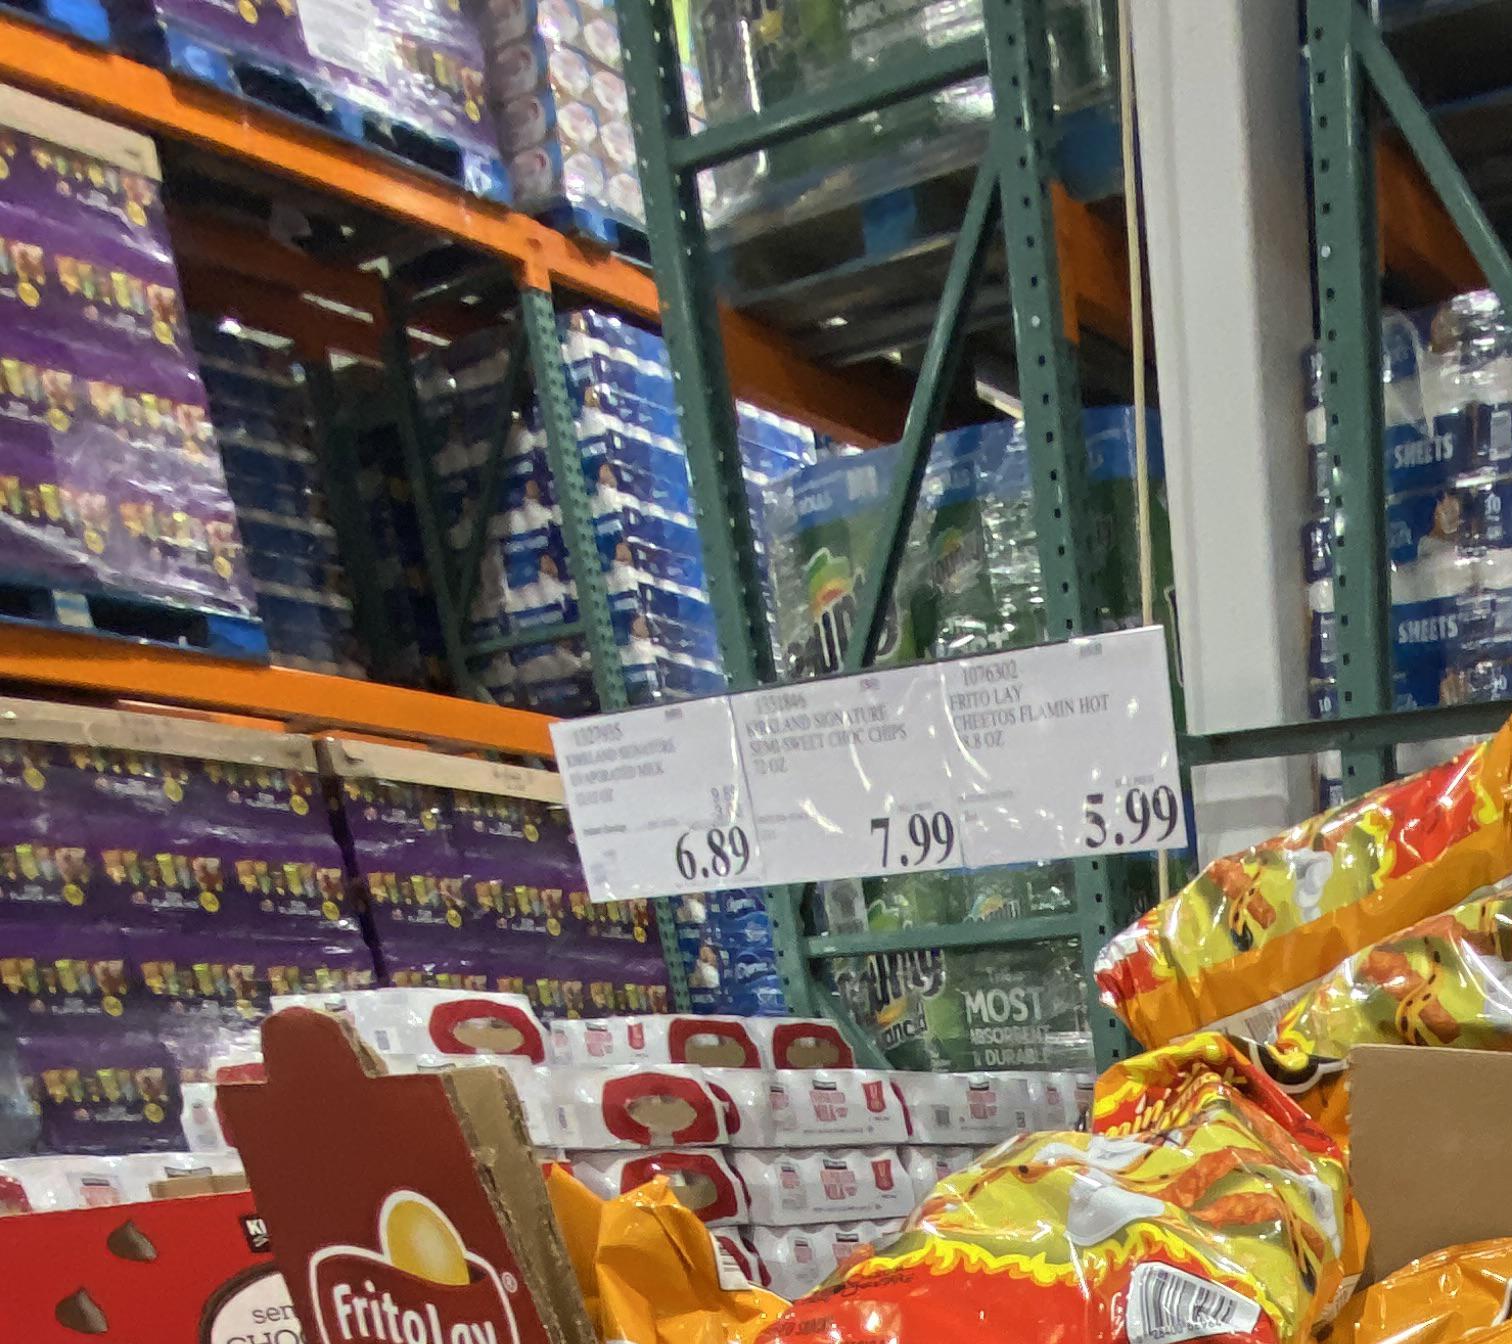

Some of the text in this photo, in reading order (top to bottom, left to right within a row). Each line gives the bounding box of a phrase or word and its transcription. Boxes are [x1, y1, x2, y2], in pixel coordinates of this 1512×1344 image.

[1398, 612, 1459, 645] SHEETS
[950, 683, 1024, 712] FRITO LAY
[1019, 698, 1076, 724] FLAMIN
[1079, 693, 1111, 714] HOT
[1084, 784, 1179, 848] 5.99
[675, 825, 750, 881] 6.89
[870, 810, 955, 868] 7.99
[963, 984, 1044, 1024] MOST
